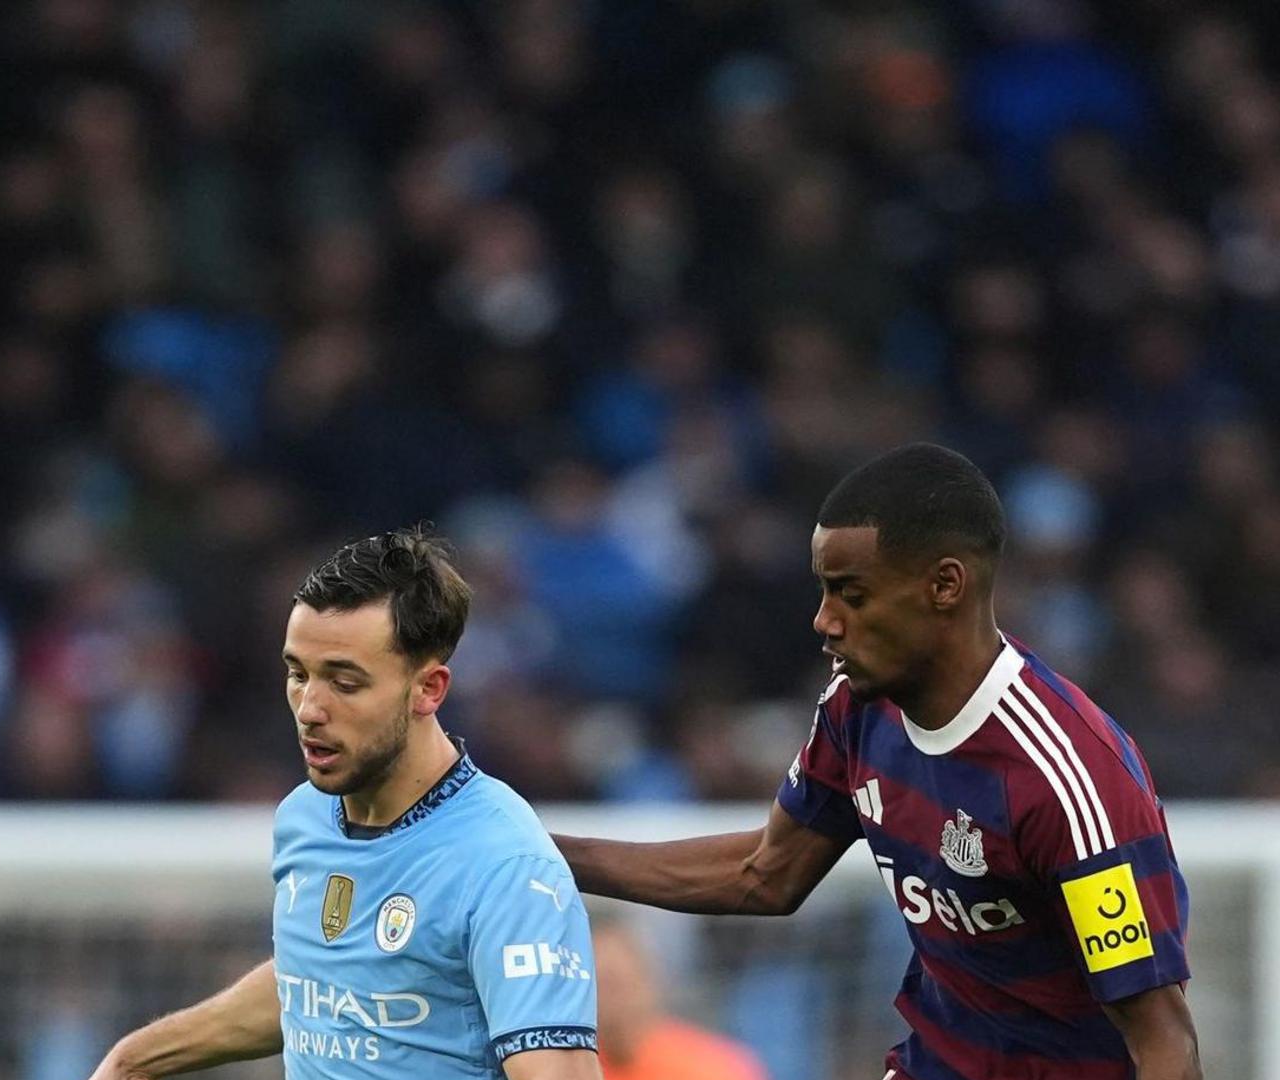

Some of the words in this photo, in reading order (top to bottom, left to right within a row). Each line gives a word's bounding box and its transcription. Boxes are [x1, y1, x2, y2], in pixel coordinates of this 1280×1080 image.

[902, 875, 1024, 936] Sela
[277, 974, 430, 1027] TIHAD
[286, 1027, 380, 1061] AIRWAYS
